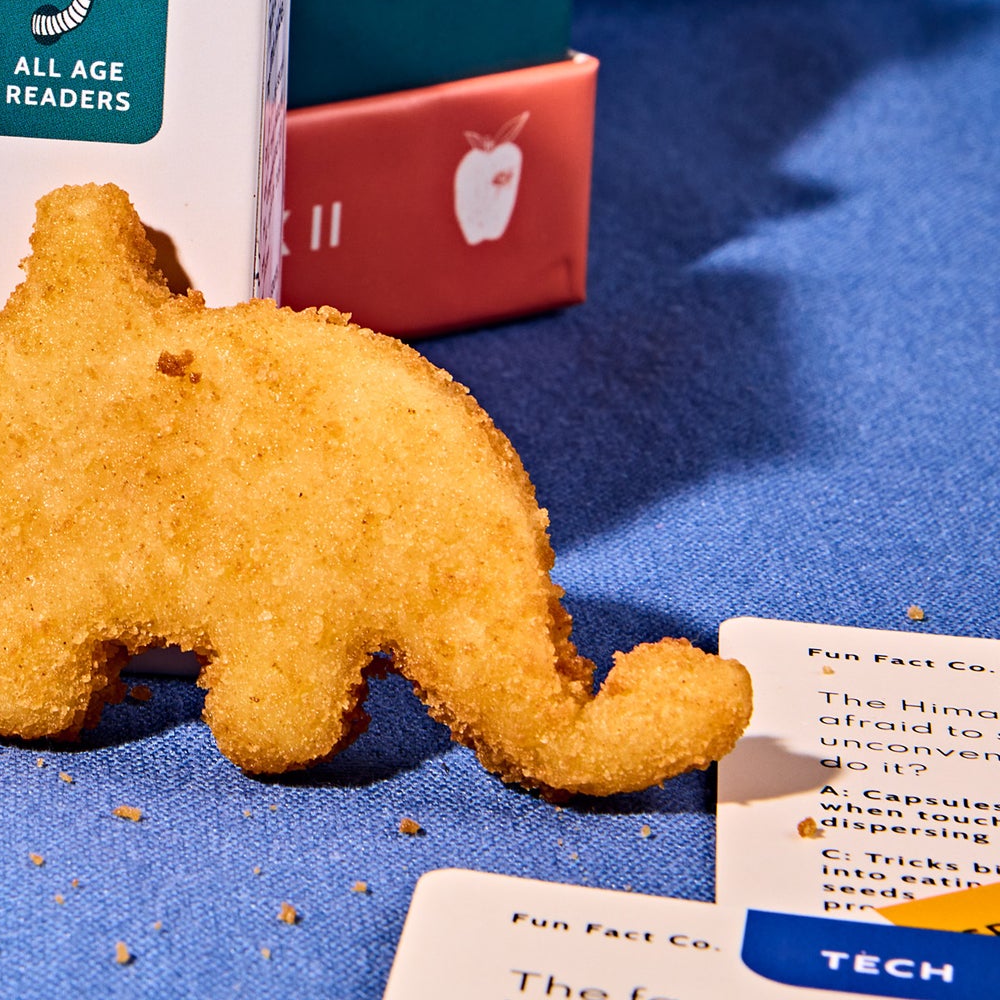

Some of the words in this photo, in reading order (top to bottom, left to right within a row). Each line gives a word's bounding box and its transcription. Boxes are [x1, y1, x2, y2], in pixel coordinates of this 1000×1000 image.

[13, 56, 61, 78] ALL
[70, 59, 124, 82] AGE
[6, 84, 131, 112] READERS
[808, 647, 860, 662] Fun
[874, 654, 935, 668] Fact
[948, 660, 996, 674] Co.
[817, 691, 887, 709] The
[819, 714, 933, 735] afraid
[948, 725, 984, 739] to
[820, 755, 868, 769] do
[883, 762, 928, 776] it?
[820, 785, 850, 797] A:
[820, 802, 905, 819] when
[820, 817, 991, 845] dispersing
[821, 848, 851, 861] C:
[864, 852, 960, 871] Tricks
[822, 864, 887, 881] into
[823, 883, 916, 900] seeds
[511, 912, 570, 931] Fun
[586, 923, 654, 943] Fact
[669, 934, 722, 952] Co.
[820, 949, 955, 984] TECH
